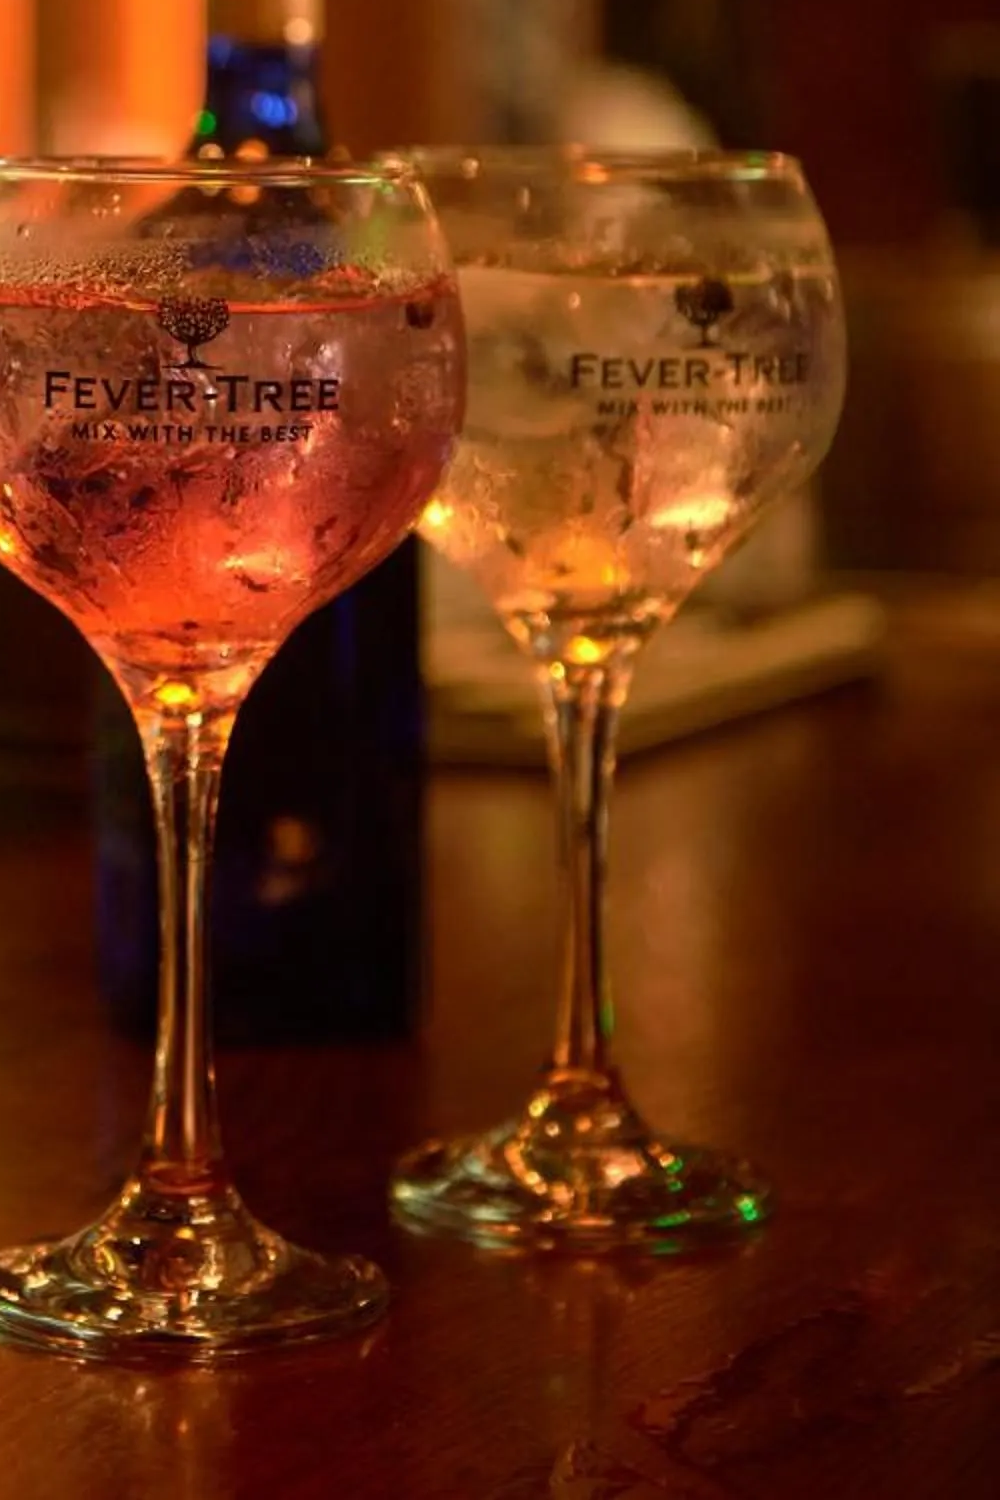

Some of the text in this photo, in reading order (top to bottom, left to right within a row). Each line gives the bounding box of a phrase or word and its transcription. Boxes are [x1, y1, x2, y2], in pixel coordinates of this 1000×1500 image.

[572, 352, 809, 390] FEVER-TREE
[44, 370, 341, 413] FEVER-TREE
[71, 424, 315, 443] MIX WITH THE BEST
